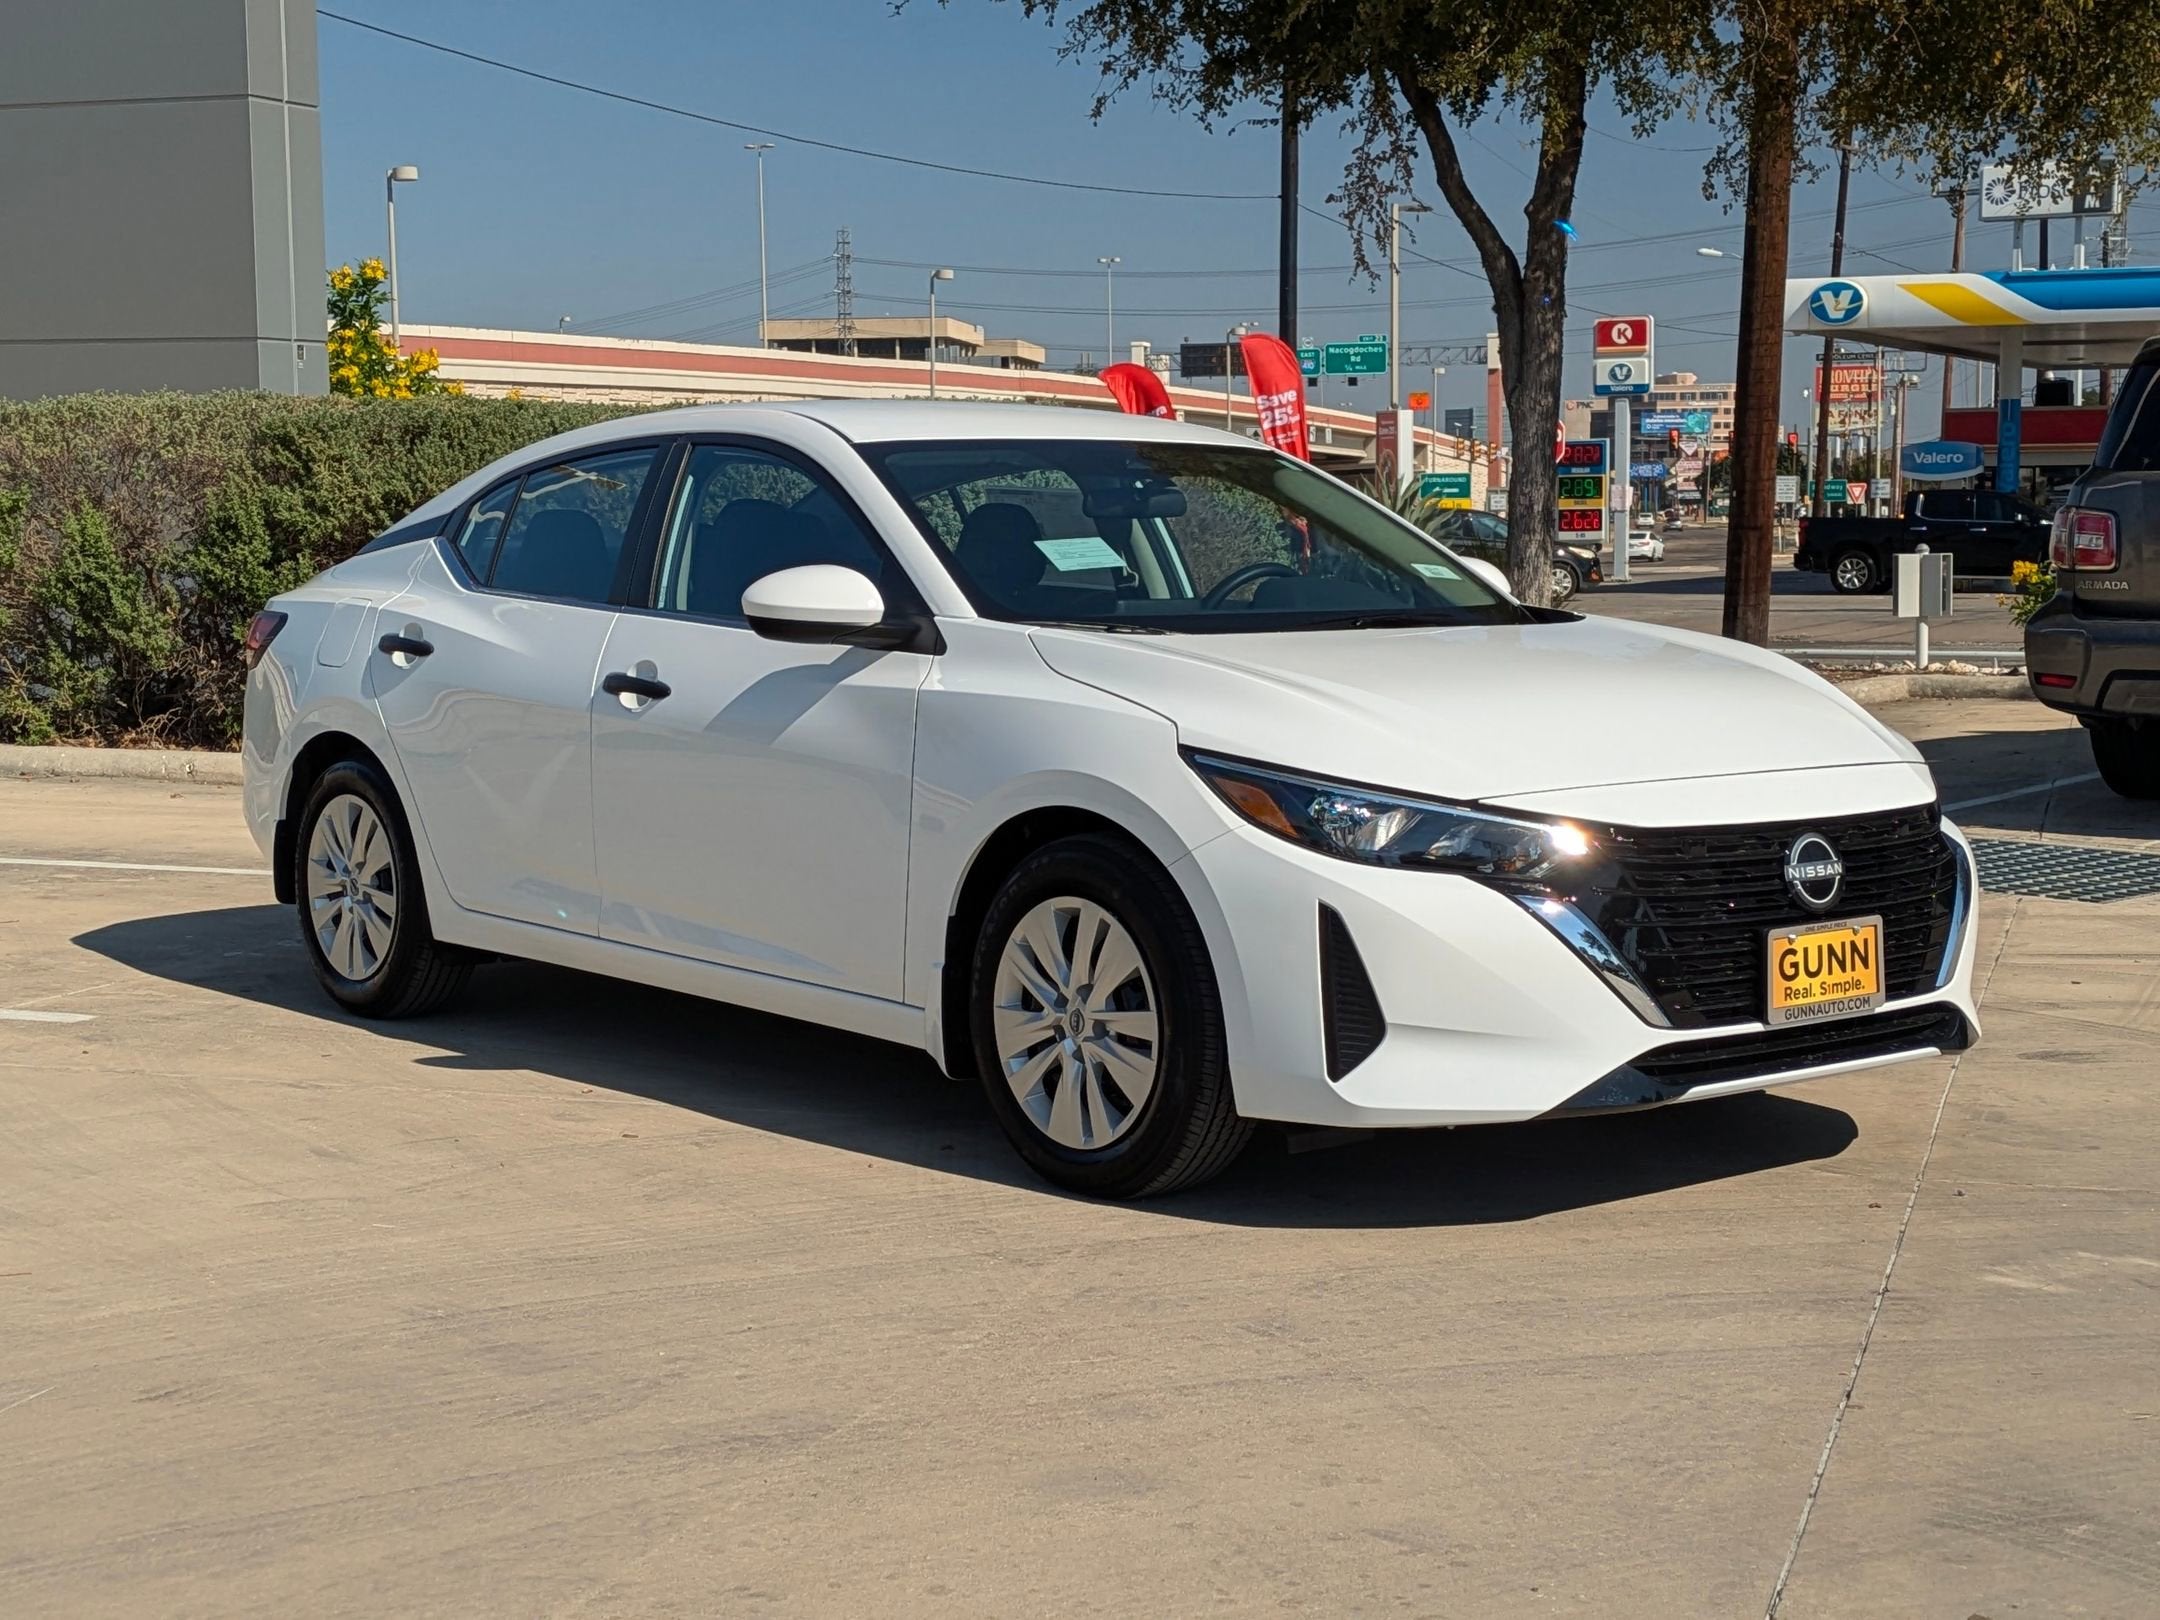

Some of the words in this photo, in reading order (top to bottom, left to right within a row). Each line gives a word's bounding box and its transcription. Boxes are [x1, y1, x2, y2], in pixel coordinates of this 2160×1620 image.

[1328, 346, 1383, 355] Nacogdoches
[1350, 355, 1361, 363] Rd
[1257, 390, 1297, 410] Save
[1913, 452, 1964, 464] Valero
[2078, 580, 2129, 590] ARMADA
[1788, 862, 1842, 879] NISSAN
[1816, 923, 1833, 931] SIMPLE
[1778, 937, 1870, 982] GUNN
[1784, 983, 1816, 1002] Real.
[1784, 996, 1871, 1021] GUNNAUTO.COM
